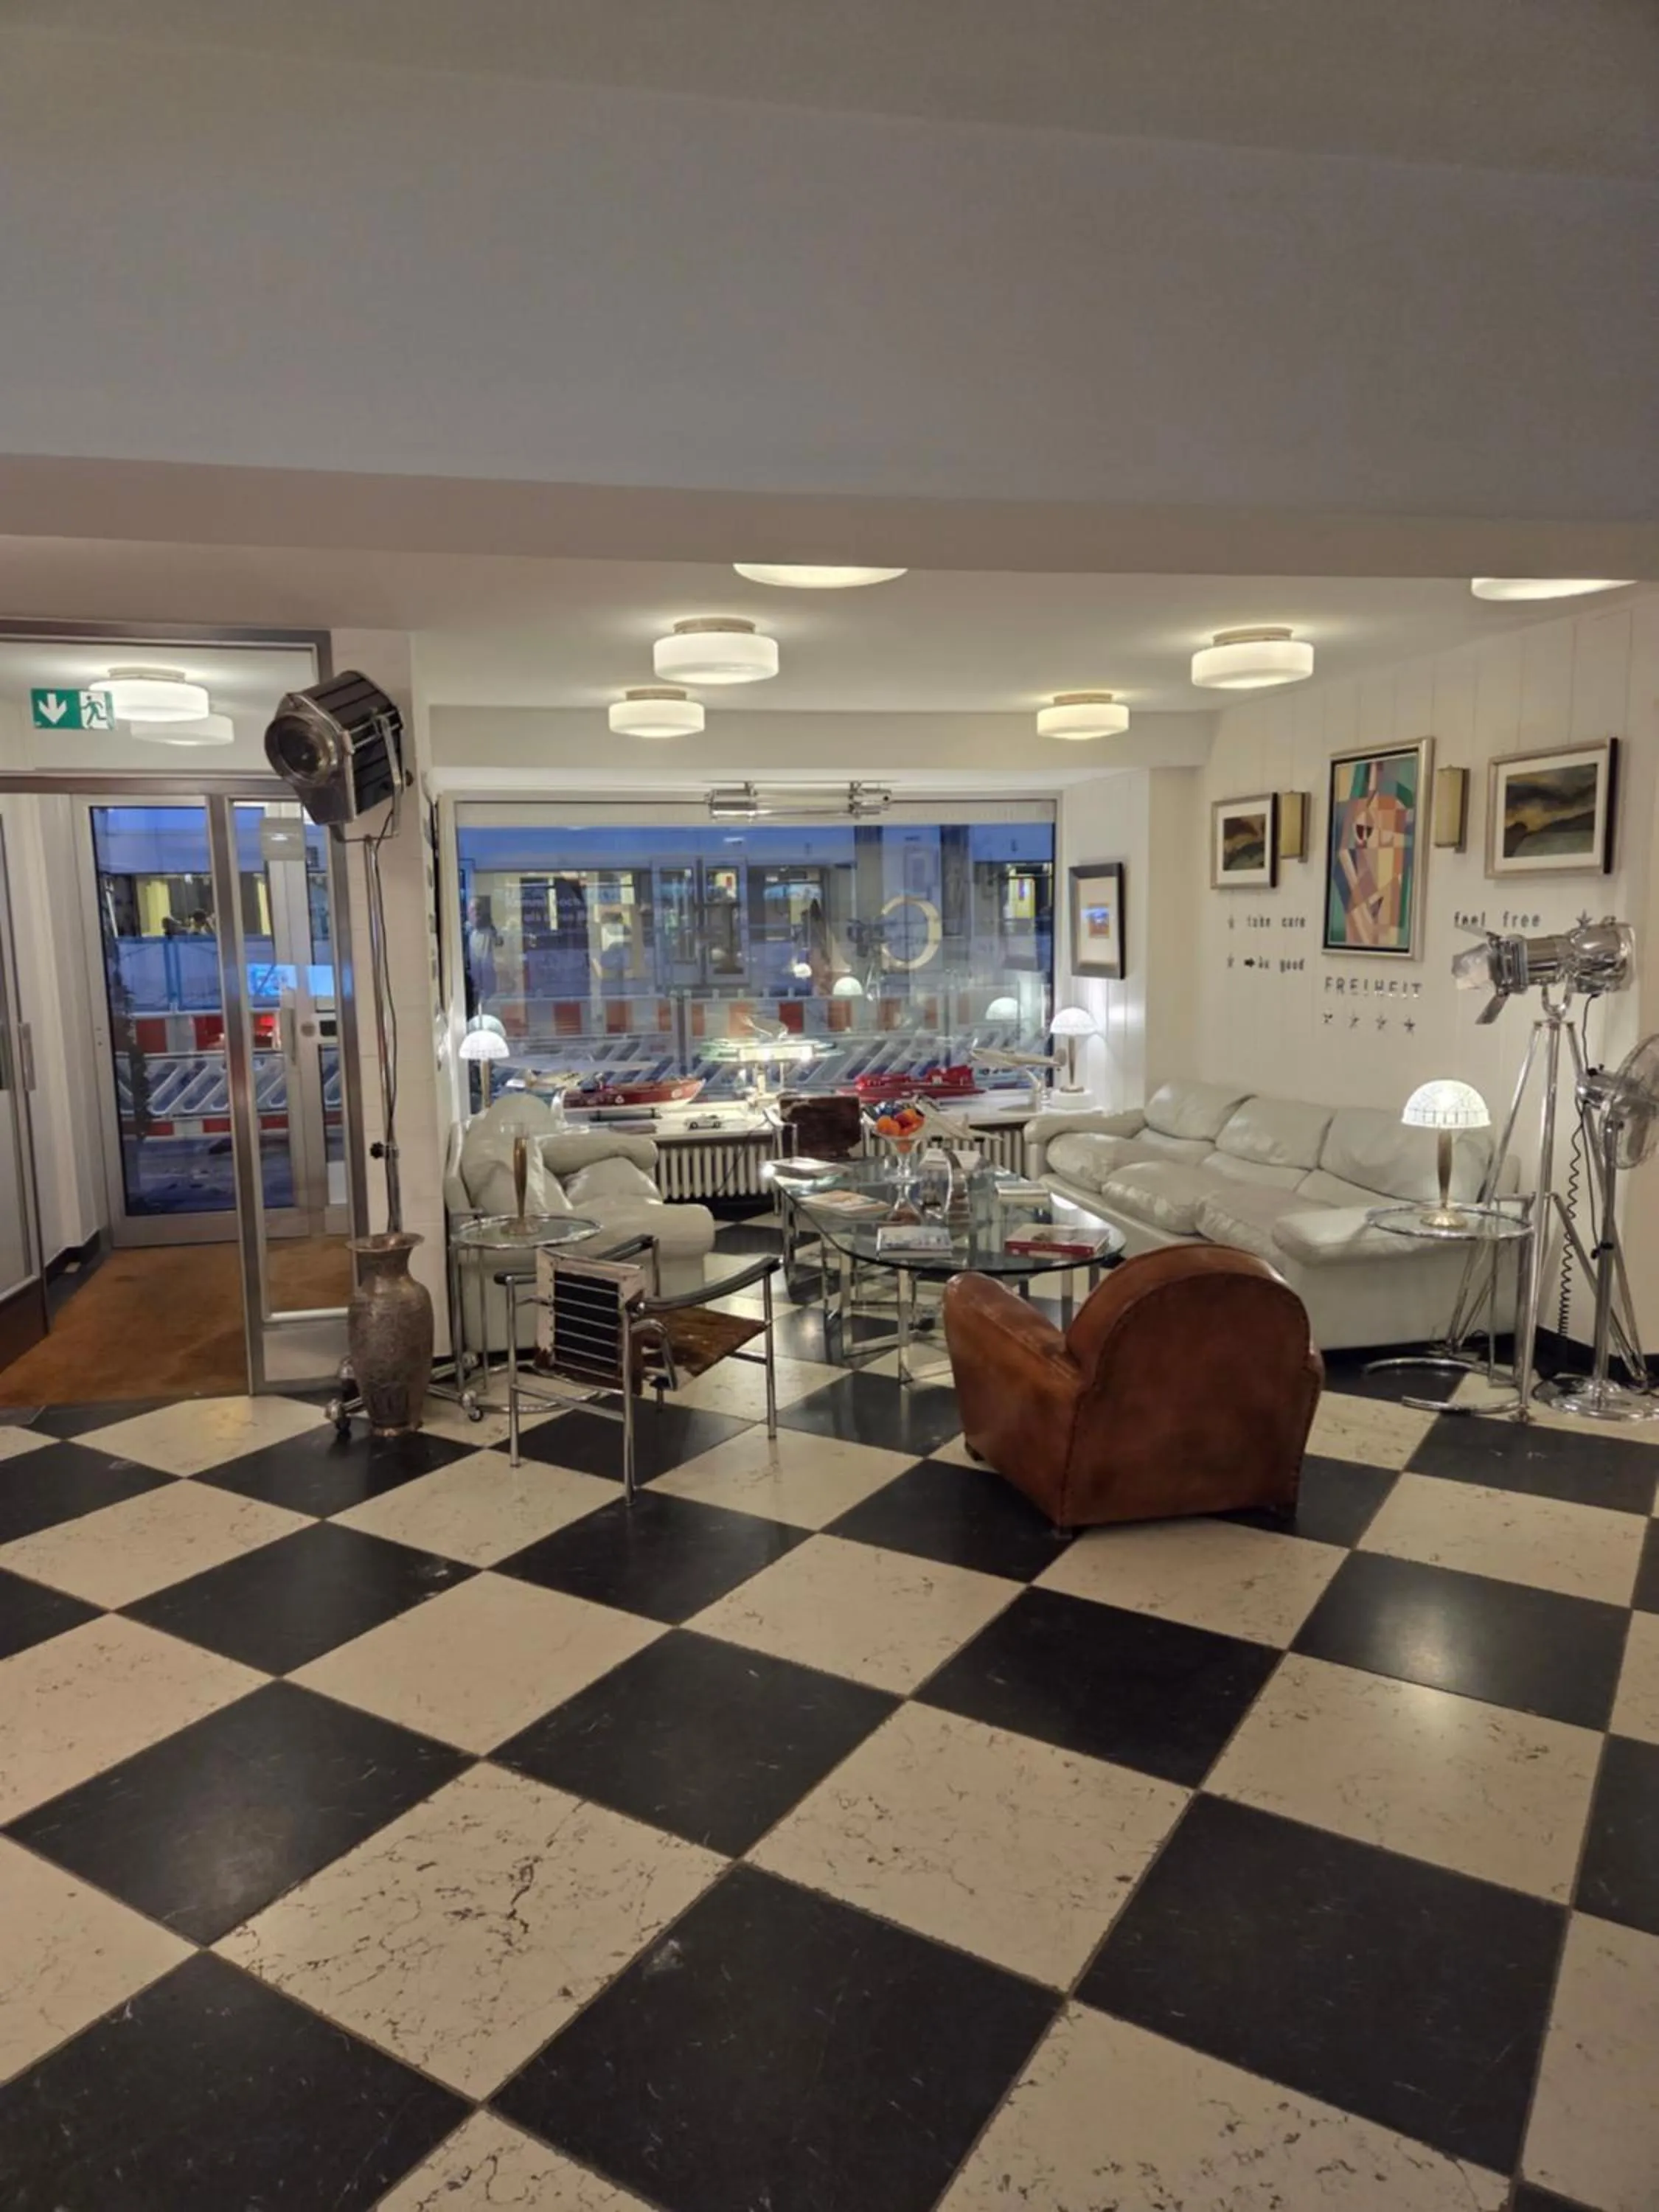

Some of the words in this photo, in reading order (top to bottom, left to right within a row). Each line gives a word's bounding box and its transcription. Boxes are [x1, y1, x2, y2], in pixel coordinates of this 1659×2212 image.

[1281, 917, 1306, 928] care
[1454, 911, 1486, 928] feel
[1503, 911, 1540, 928] free
[1280, 959, 1304, 973] good
[1324, 975, 1422, 997] FREIHEIT
